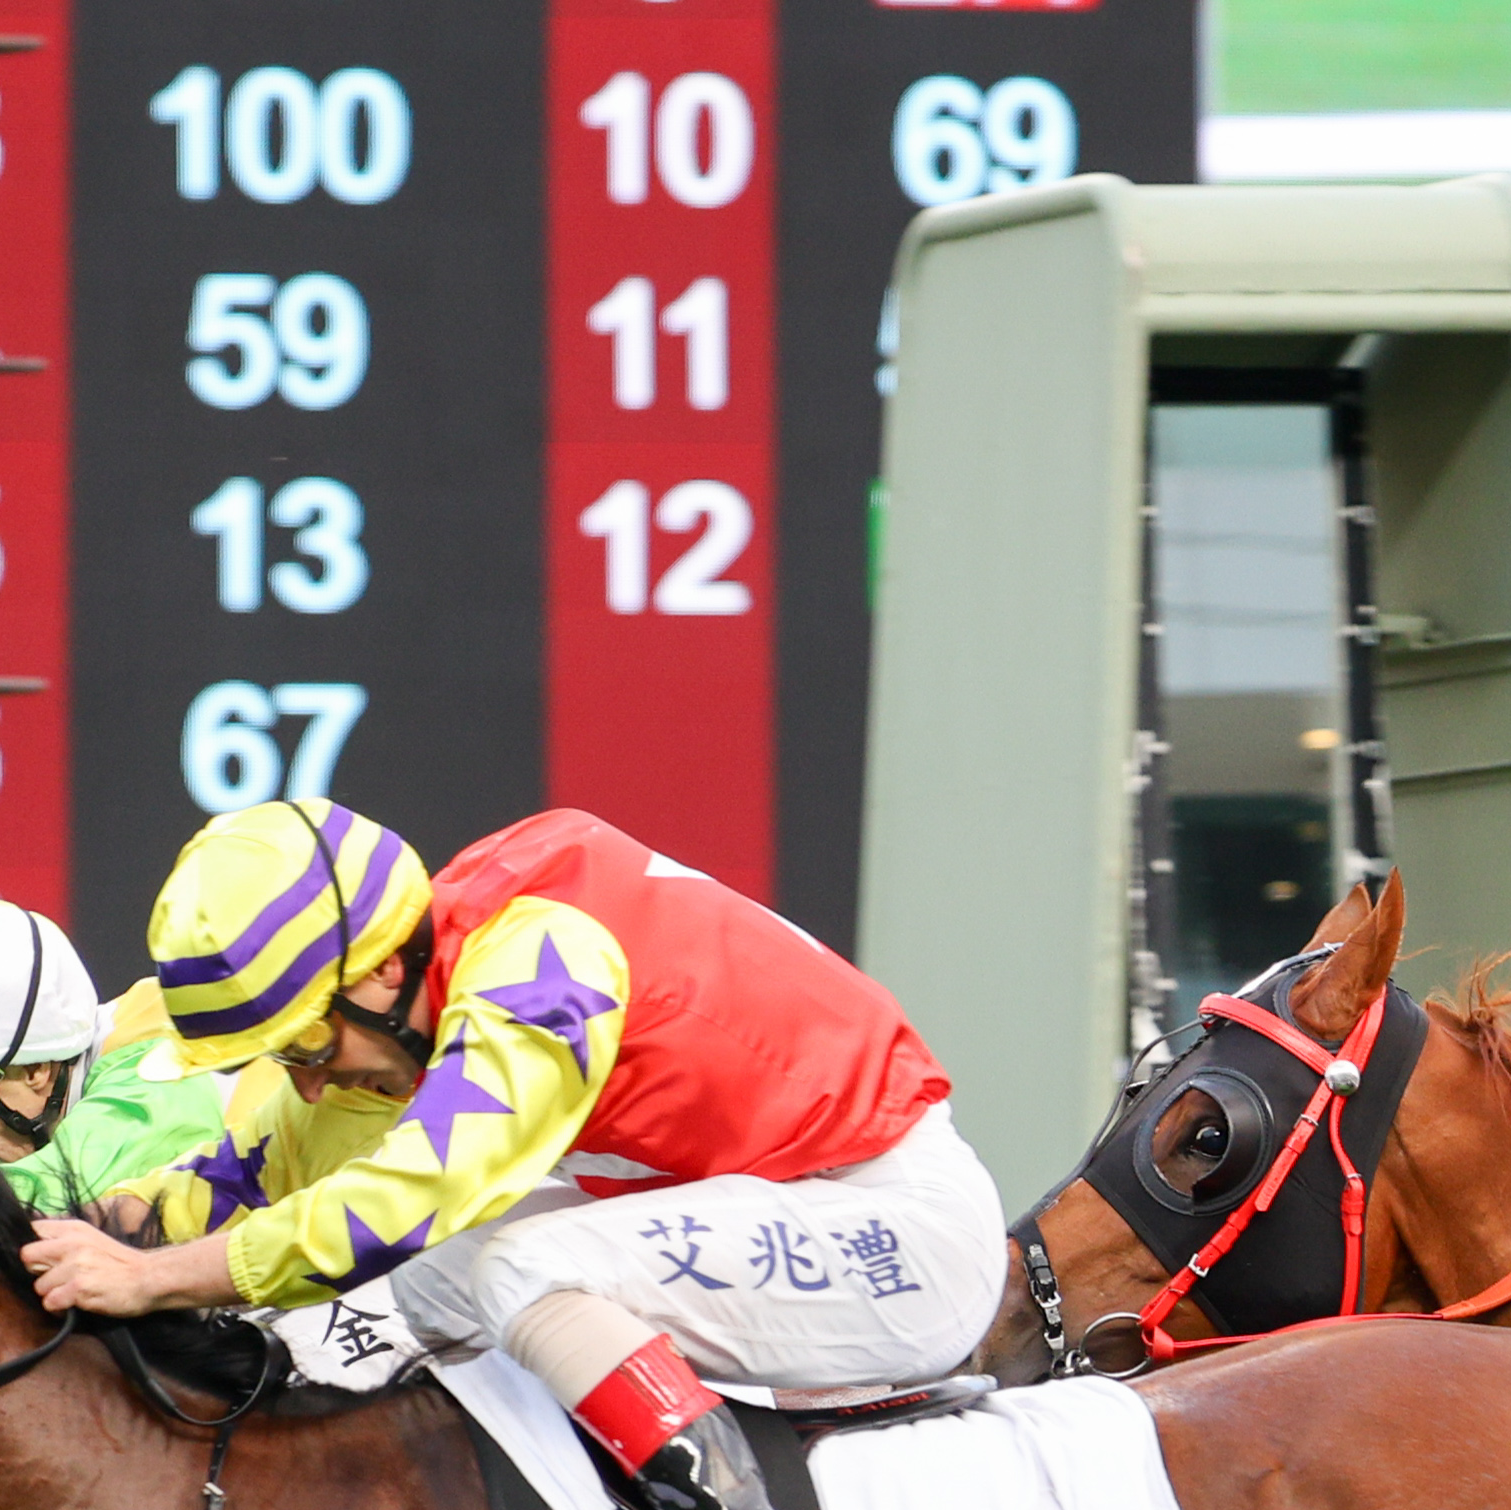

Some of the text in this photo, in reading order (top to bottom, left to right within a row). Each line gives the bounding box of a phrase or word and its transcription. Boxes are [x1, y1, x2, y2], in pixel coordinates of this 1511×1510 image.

[150, 66, 413, 205] 100
[580, 72, 754, 208] 10
[892, 75, 1078, 205] 69
[186, 272, 370, 411] 59
[586, 277, 729, 410] 11
[190, 477, 369, 614] 13
[579, 480, 752, 615] 12
[181, 680, 367, 812] 67
[321, 1299, 394, 1368] 金
